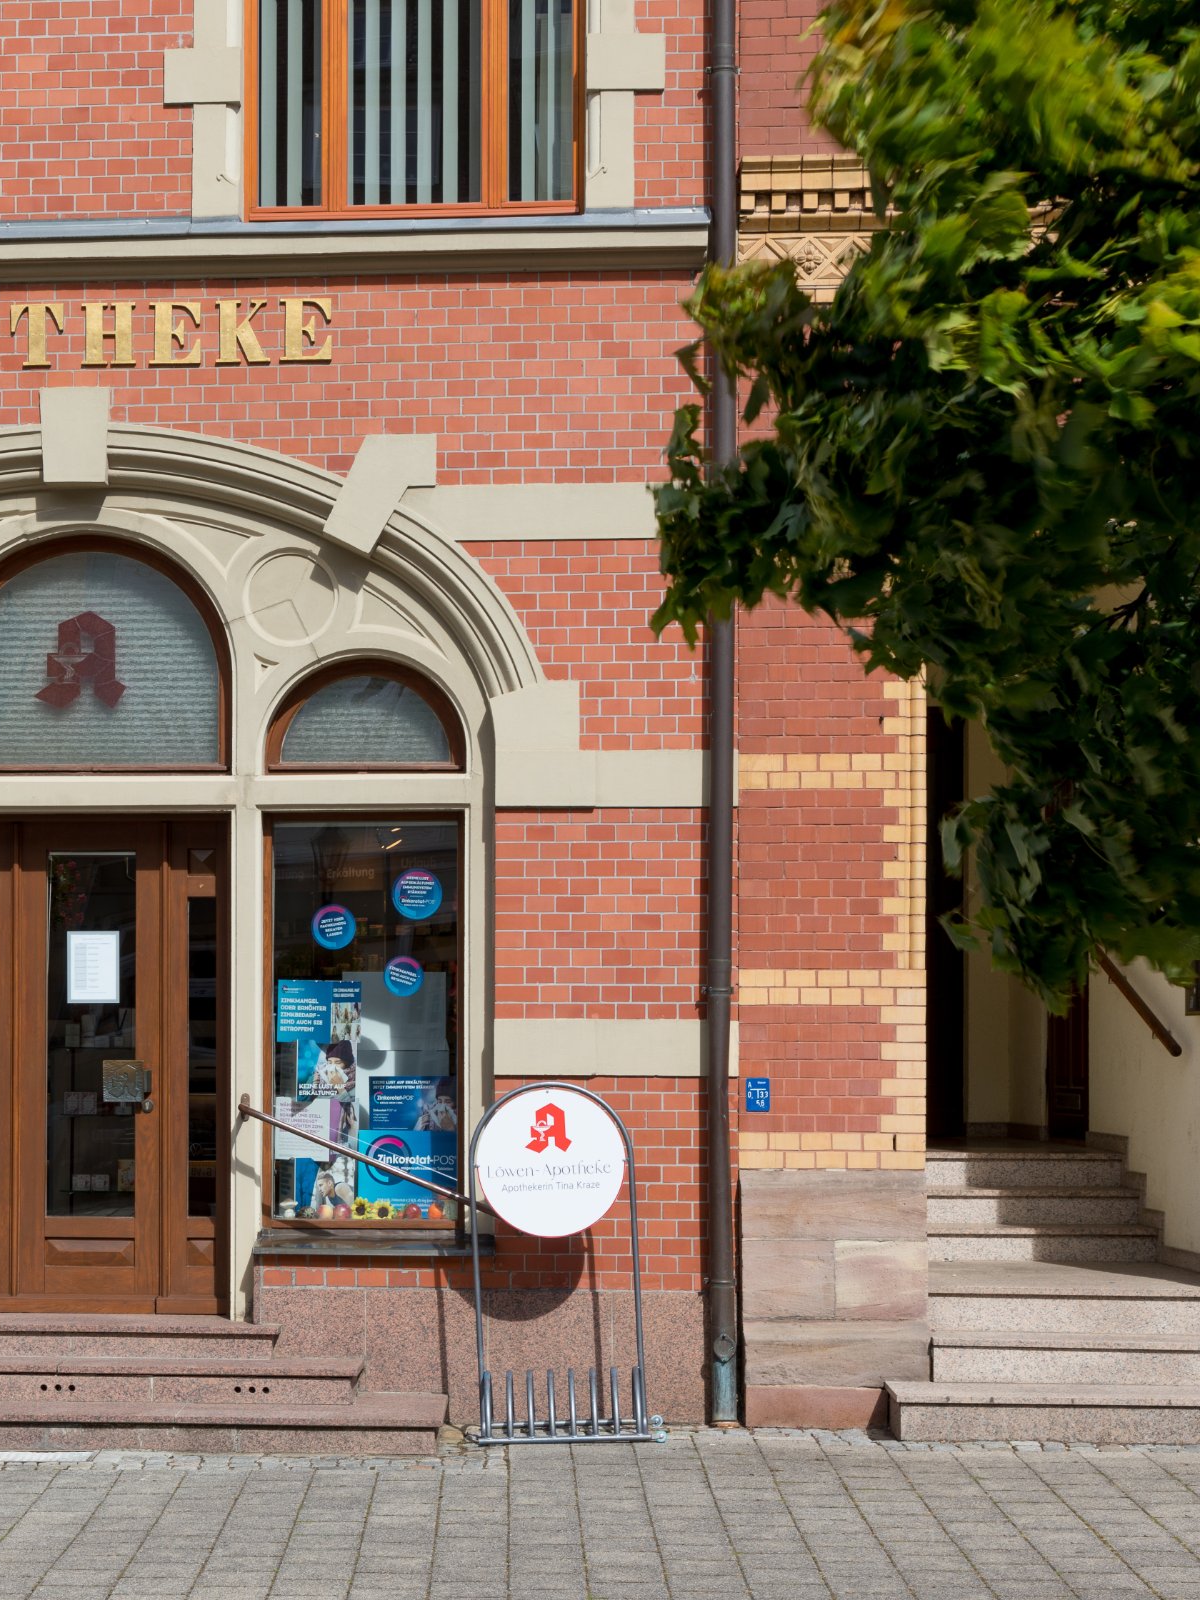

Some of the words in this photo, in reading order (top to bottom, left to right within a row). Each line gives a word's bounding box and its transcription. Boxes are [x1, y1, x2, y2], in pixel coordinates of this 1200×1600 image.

[326, 867, 375, 880] Erkältung
[487, 1159, 612, 1180] Löwen-Apotheke
[501, 1183, 554, 1193] Apothekerin
[555, 1182, 574, 1190] Tina
[576, 1180, 600, 1190] Kraze
